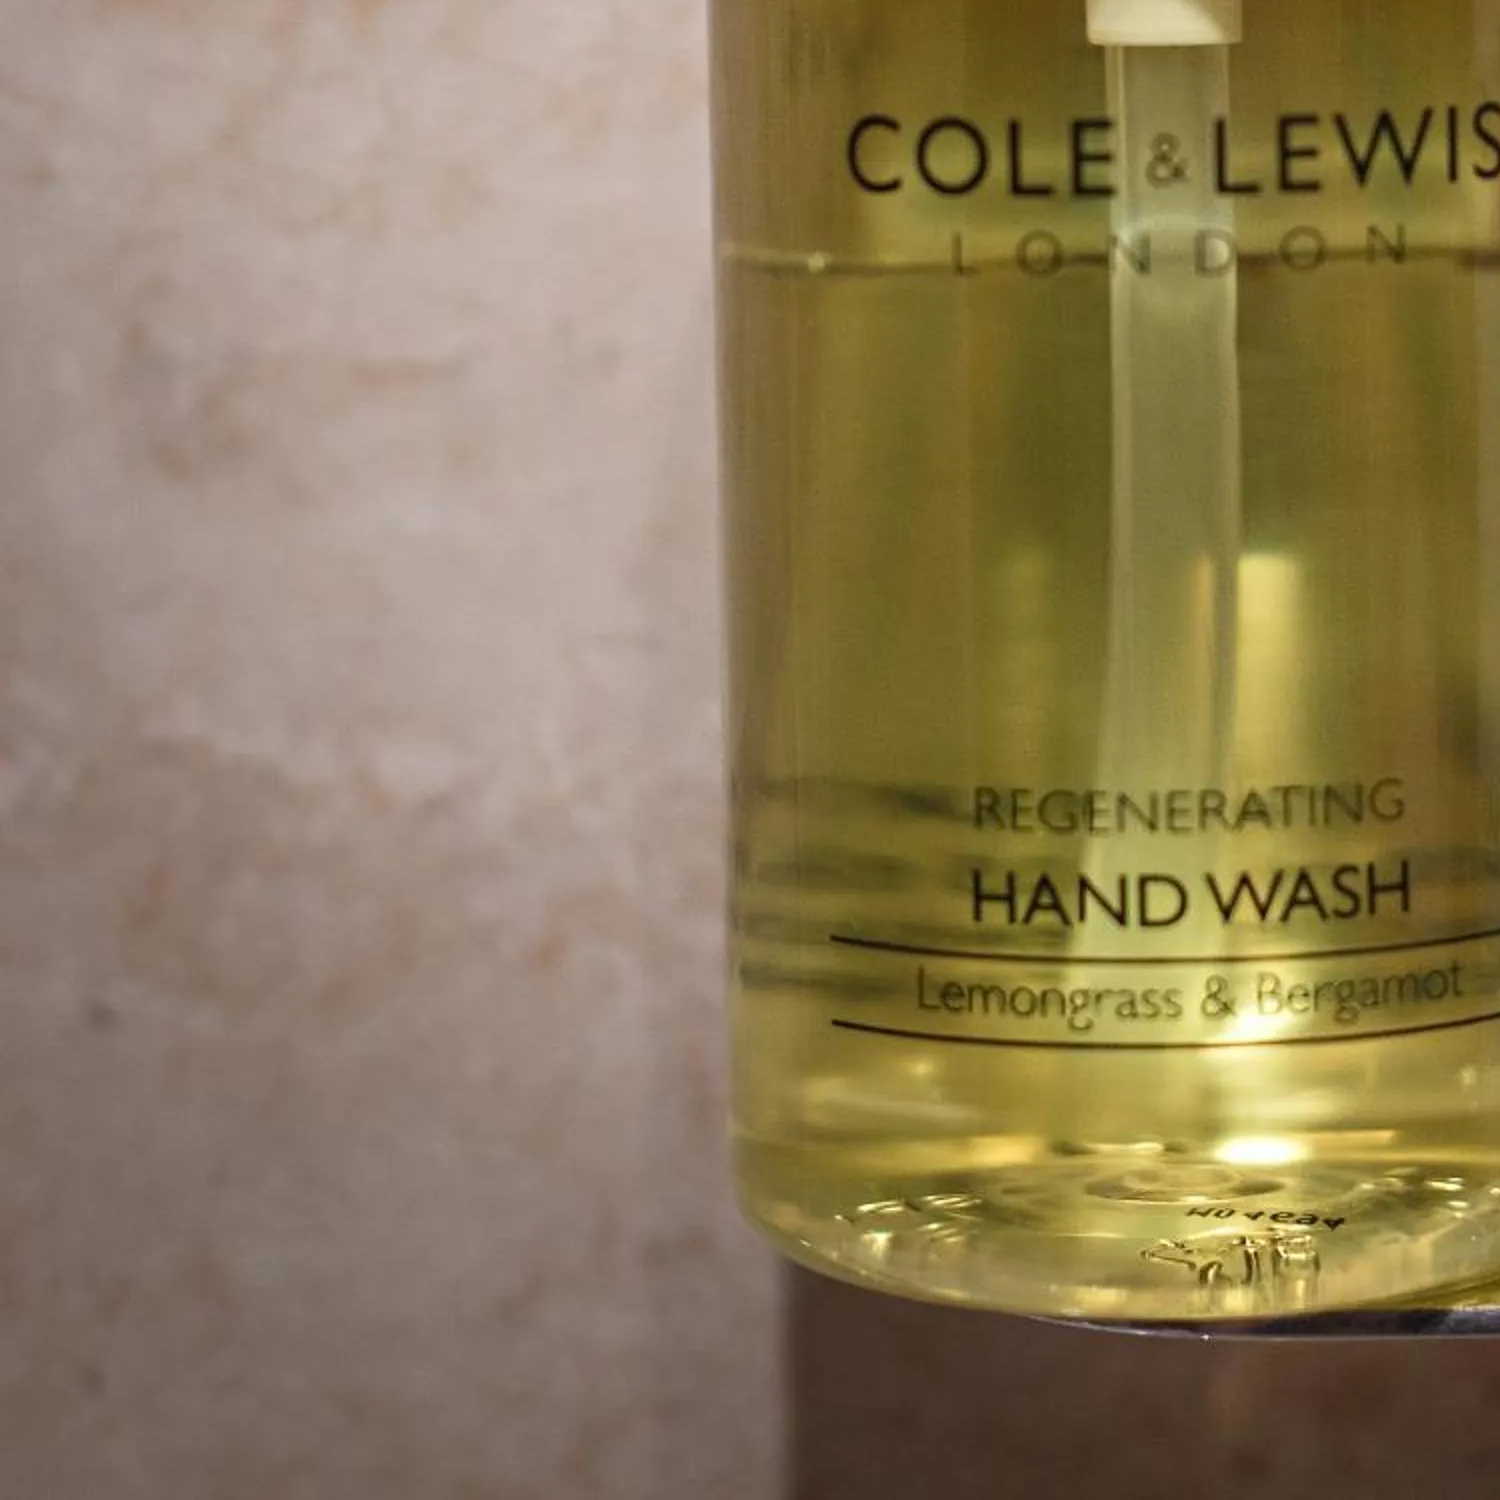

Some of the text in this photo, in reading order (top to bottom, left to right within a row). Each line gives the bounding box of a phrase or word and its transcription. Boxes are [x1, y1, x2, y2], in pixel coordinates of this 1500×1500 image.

[847, 114, 1117, 197] COLE
[1145, 132, 1190, 189] &
[951, 224, 1407, 277] LONDON
[971, 777, 1407, 836] REGENERATING
[971, 860, 1411, 928] HAND WASH
[916, 960, 1464, 1032] Lemongrass & Bergamot
